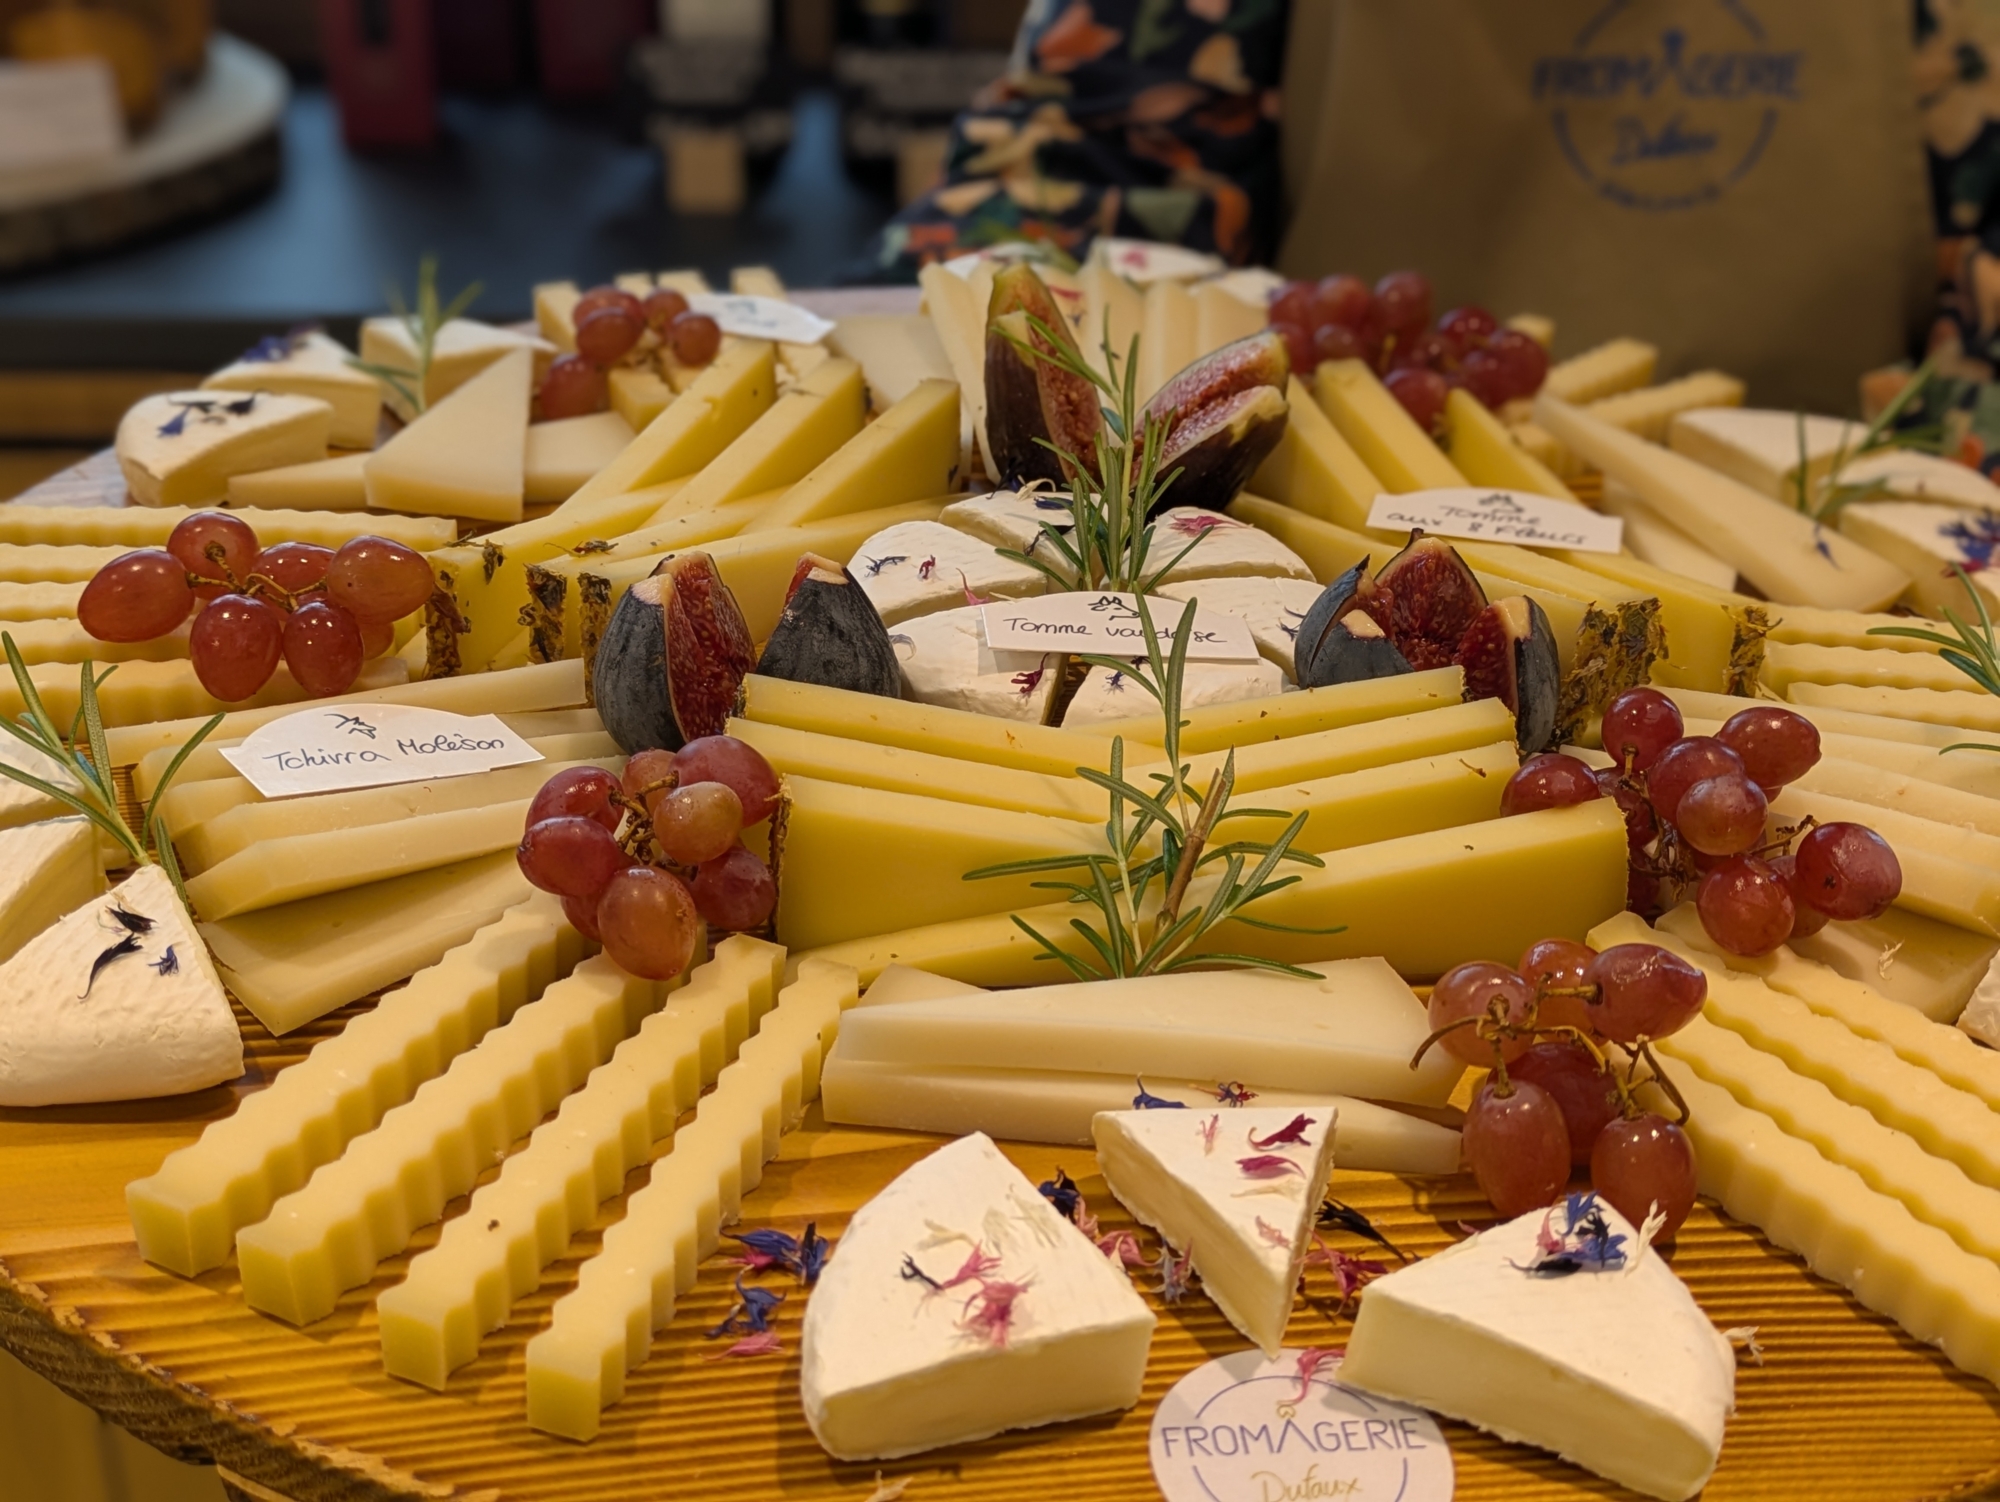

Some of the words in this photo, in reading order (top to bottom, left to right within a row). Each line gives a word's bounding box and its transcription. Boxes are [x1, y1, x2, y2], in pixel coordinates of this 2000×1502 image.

[1438, 504, 1542, 526] Tomme
[1003, 617, 1093, 636] Tomme
[1161, 1417, 1427, 1458] FROMAGERIE
[1251, 1463, 1364, 1502] Dufaux
